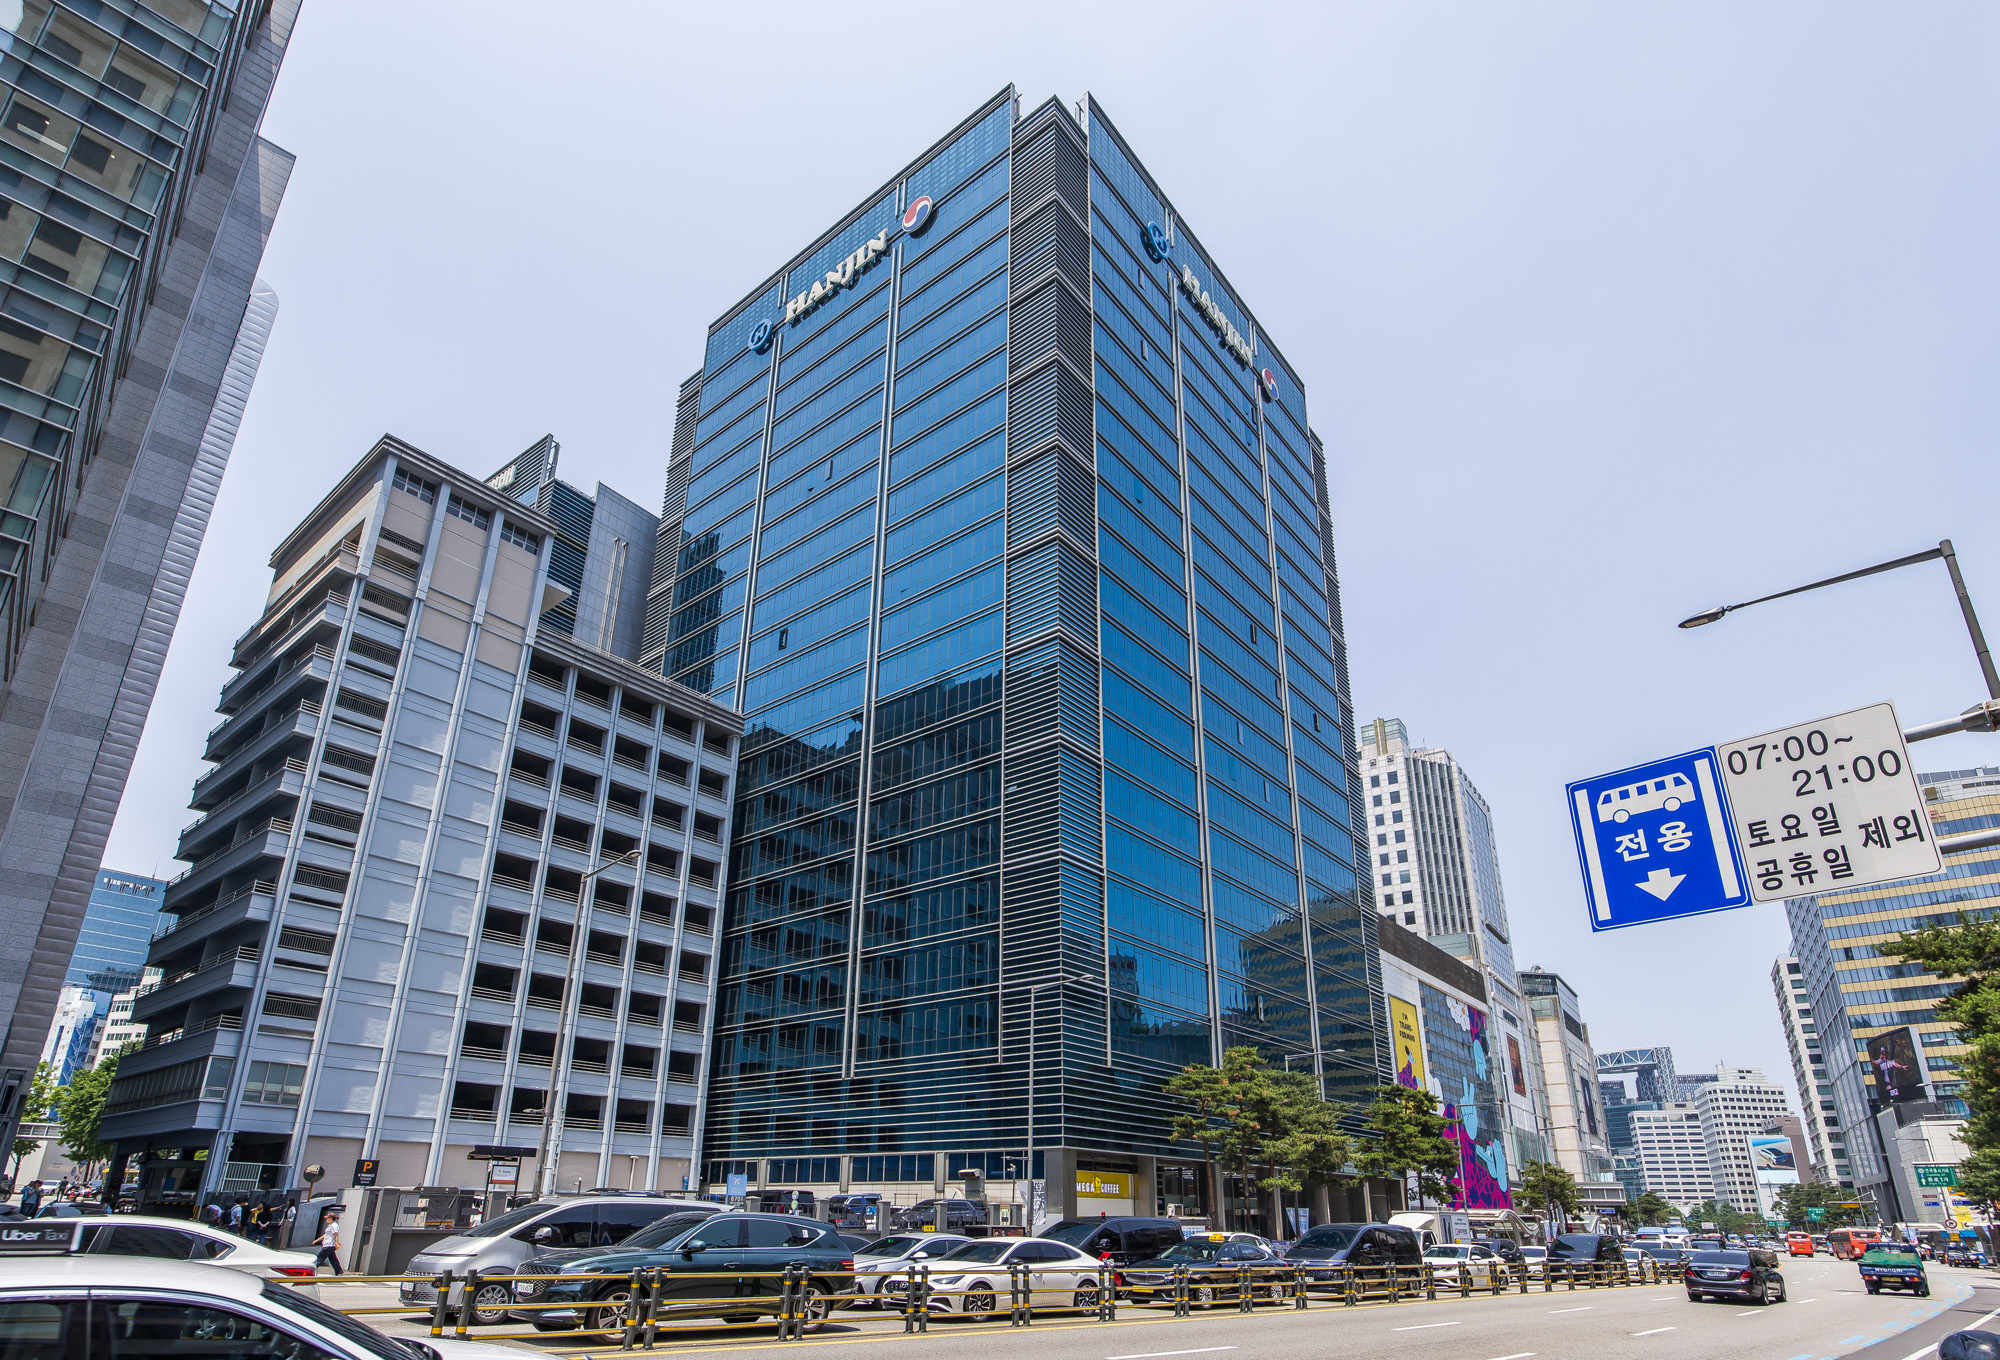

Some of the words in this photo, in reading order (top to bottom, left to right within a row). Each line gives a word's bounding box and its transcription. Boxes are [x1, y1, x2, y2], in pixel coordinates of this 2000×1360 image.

[785, 228, 889, 324] HANJIN
[1183, 264, 1254, 368] HANJIN
[1728, 729, 1854, 776] 07:00~
[1792, 749, 1902, 797] 21:00
[1615, 821, 1693, 863] 전용
[1748, 802, 1842, 849] 토요일
[1858, 809, 1925, 850] 제외
[1757, 844, 1855, 892] 공휴일
[363, 1161, 373, 1173] P
[1076, 1182, 1095, 1193] MEGA
[1100, 1183, 1120, 1194] COFFEE
[1, 1229, 42, 1241] Uber
[43, 1229, 71, 1241] Taxi
